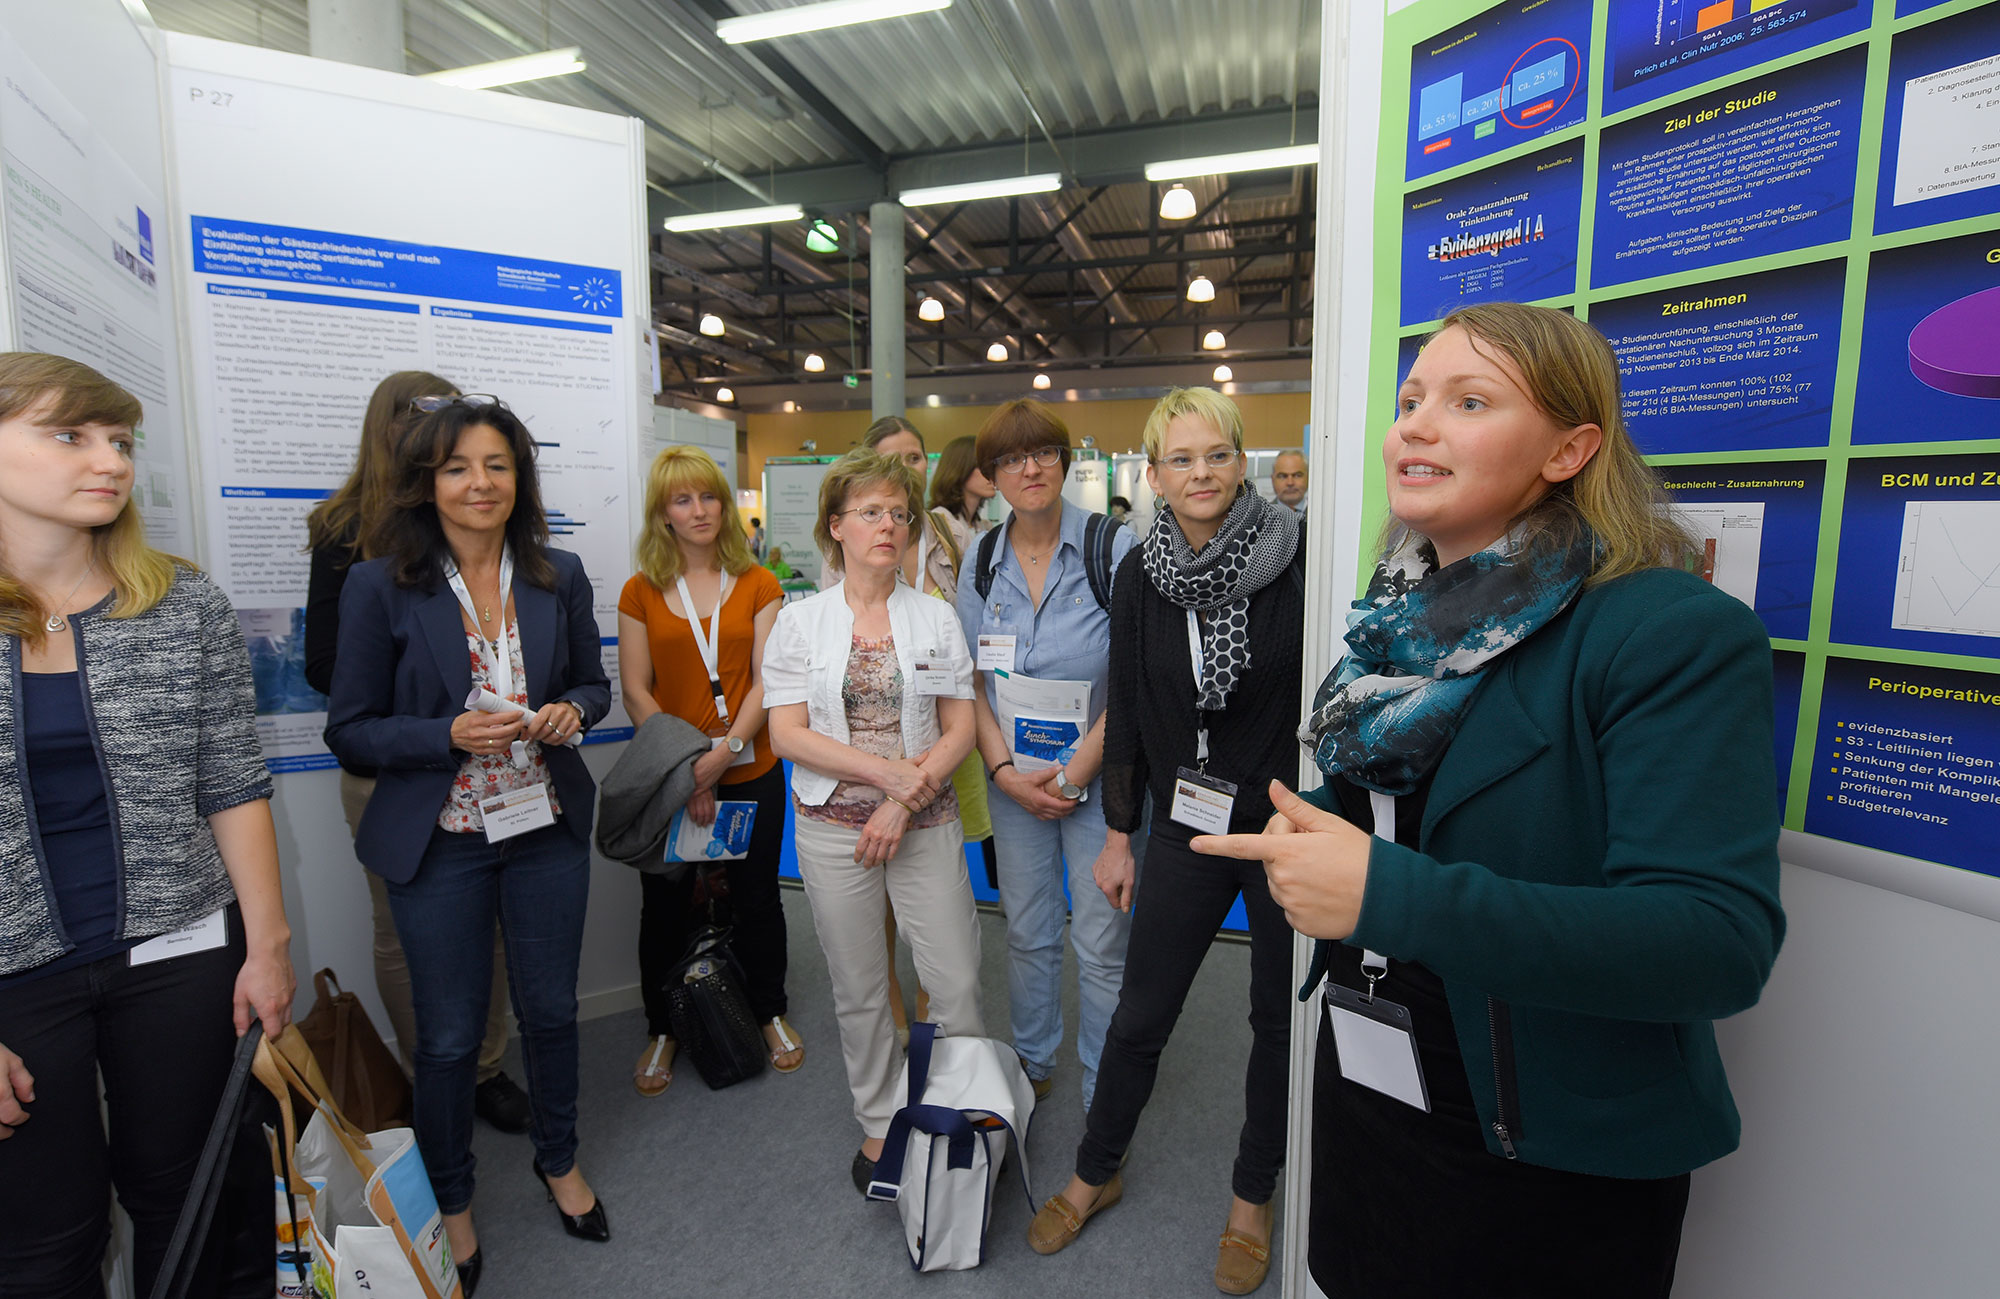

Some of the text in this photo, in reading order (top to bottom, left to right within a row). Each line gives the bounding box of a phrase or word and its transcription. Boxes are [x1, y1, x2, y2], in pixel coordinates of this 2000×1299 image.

[1634, 9, 1807, 77] Pirlich et al, Clin Nutr 2006; 25: 563-574
[1518, 68, 1558, 91] ca. 25 %
[1915, 58, 1993, 84] Patientenvorstellung
[190, 88, 234, 107] P 27
[1962, 86, 1992, 100] Klärung
[1467, 105, 1478, 116] ca.
[1481, 99, 1492, 111] 20
[1665, 89, 1777, 134] Ziel der Studie
[1422, 111, 1456, 132] ca. 55 %
[1624, 159, 1639, 167] dem
[1642, 139, 1699, 162] Studienprotokoll
[1702, 134, 1715, 144] soll
[1727, 115, 1782, 137] vereinfachten
[1786, 99, 1840, 119] Herangehen
[1536, 156, 1572, 172] Behandlung
[1617, 121, 1831, 187] zentrischen Studie untersucht werden, wie effektiv sich
[1635, 160, 1664, 173] Rahmen
[1667, 154, 1685, 163] einer
[1927, 173, 1996, 191] Datenauswertung
[1446, 192, 1529, 221] Orale Zusatznahrung
[1617, 201, 1644, 212] Routine
[1657, 188, 1688, 202] häufigen
[1672, 192, 1753, 216] Versorgung auswirkt.
[1459, 208, 1514, 229] Trinknahrung
[1534, 214, 1544, 241] A
[202, 227, 441, 265] Evaluation der Gästezufriedenheit vor und nach
[202, 239, 384, 269] Einführung eines DGE-zertifizierten
[203, 250, 322, 272] Verpflegungsangebots
[210, 285, 267, 298] Fragestellung
[432, 308, 473, 319] Ergebnisse
[1662, 293, 1747, 316] Zeitrahmen
[1622, 326, 1710, 344] Studiendurchführung,
[1714, 315, 1776, 330] einschließlich
[1781, 312, 1798, 320] der
[1669, 330, 1753, 347] Nachuntersuchung
[1766, 323, 1803, 334] Monate
[1619, 346, 1802, 375] ang November 2013 bis Ende März 2014.
[1626, 347, 1698, 364] Studieneinschluß,
[1703, 343, 1733, 353] vollzog
[1737, 340, 1755, 349] sich
[1774, 333, 1818, 345] Zeitraum
[1629, 389, 1657, 397] diesem
[1660, 385, 1697, 394] Zeitraum
[1700, 380, 1736, 389] konnten
[1740, 376, 1766, 385] 100%
[1770, 373, 1792, 384] (102
[1643, 398, 1658, 406] 21d
[1660, 397, 1668, 405] (4
[1672, 389, 1744, 403] BIA-Messungen)
[1748, 387, 1766, 396] und
[1770, 385, 1792, 394] 75%
[1795, 382, 1812, 393] (77
[1660, 407, 1668, 415] (5
[1671, 400, 1744, 414] BIA-Messungen)
[1747, 397, 1799, 407] untersucht
[1664, 480, 1804, 489] Geschlecht Zusatznahrung
[1881, 473, 1929, 487] BCM
[1935, 472, 1975, 486] und
[1869, 677, 2000, 706] Perioperative
[1030, 737, 1065, 746] SYMPOSIUM
[1849, 722, 1953, 745] evidenzbasiert
[1845, 751, 1906, 772] Senkung
[1910, 763, 1934, 775] der
[1847, 736, 1864, 746] S3
[1877, 740, 1942, 760] Leitlinien
[1947, 751, 1994, 768] liegen
[1840, 781, 1912, 801] profitieren
[1843, 767, 1907, 787] Patienten
[1911, 781, 1934, 792] mit
[1838, 794, 1949, 825] Budgetrelevanz
